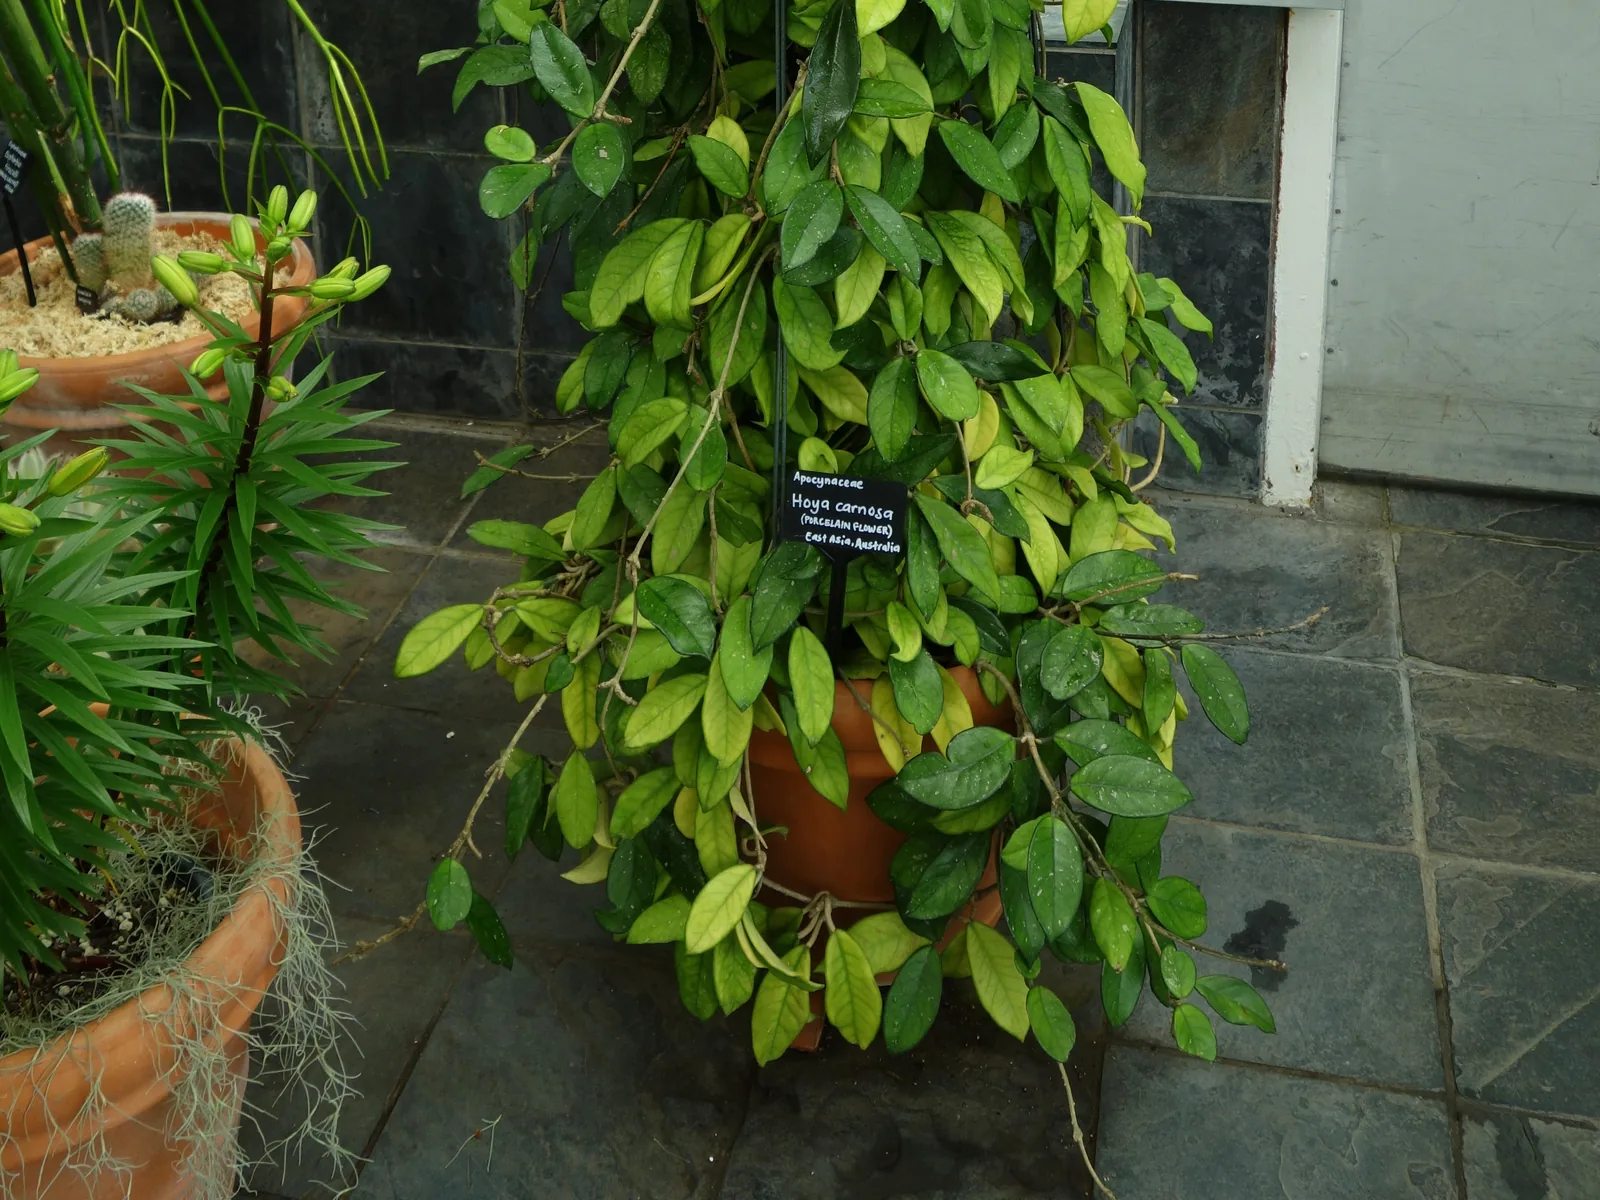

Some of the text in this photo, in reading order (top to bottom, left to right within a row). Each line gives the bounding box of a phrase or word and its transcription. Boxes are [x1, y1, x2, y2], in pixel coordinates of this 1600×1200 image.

[793, 471, 864, 489] Apocynaceae
[792, 493, 894, 521] Hoya carnosa
[800, 513, 893, 539] (PORCELAIN FLOWER)
[805, 532, 827, 543] East
